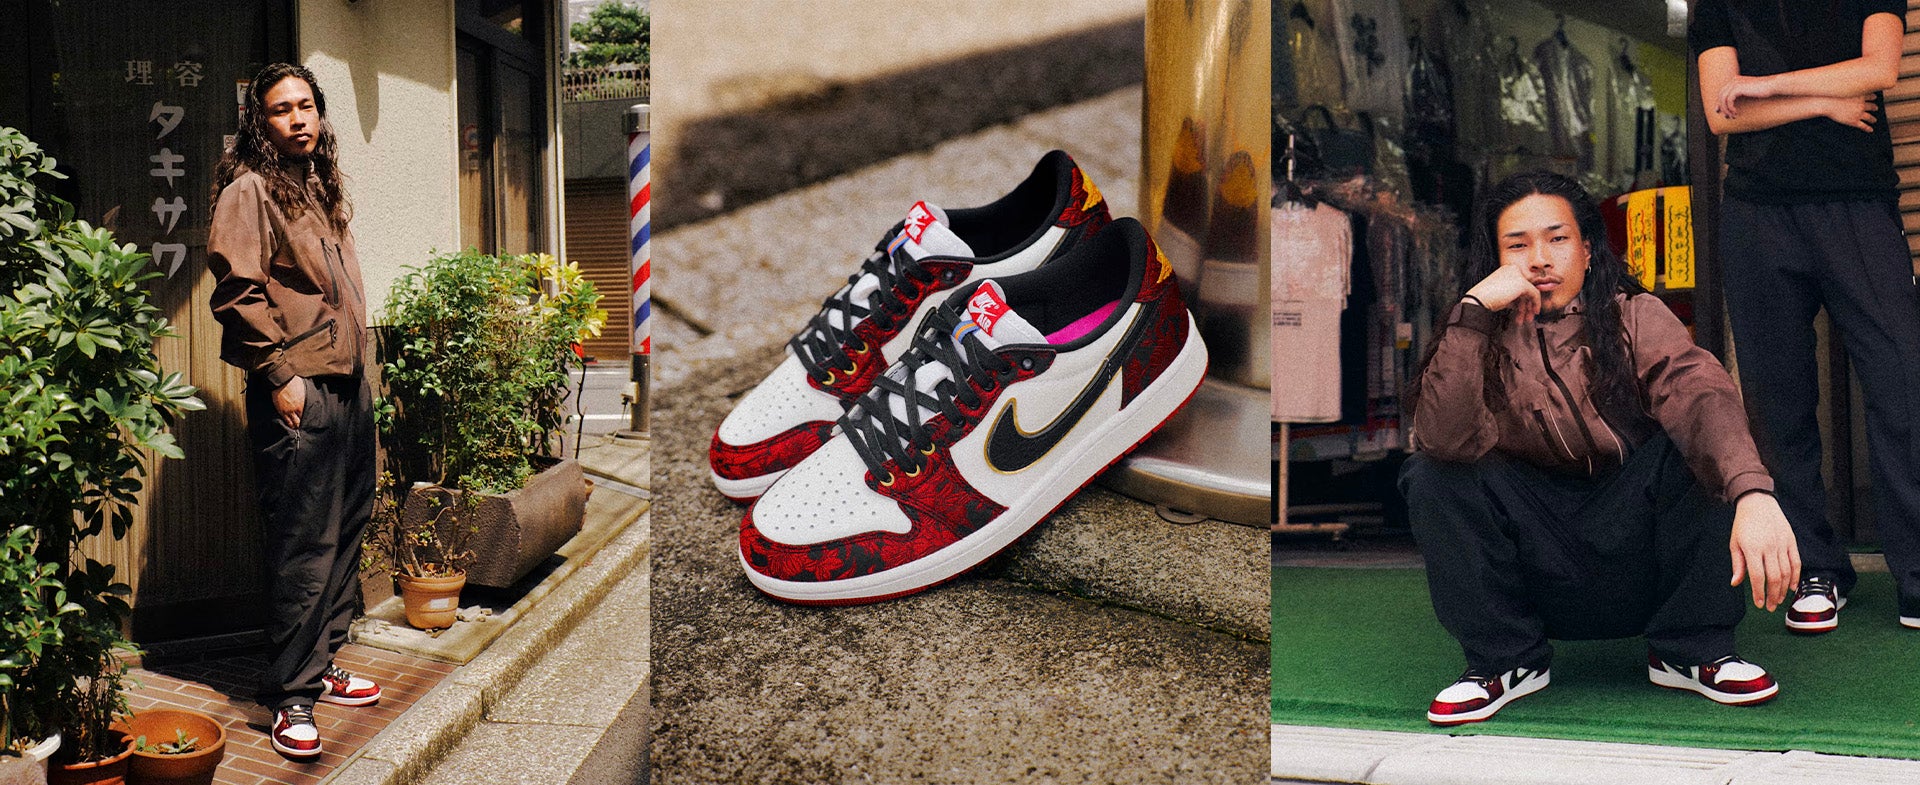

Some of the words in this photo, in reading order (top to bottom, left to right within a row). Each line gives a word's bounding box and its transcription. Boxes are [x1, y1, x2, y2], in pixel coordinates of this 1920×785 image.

[125, 59, 205, 87] 理容
[149, 101, 187, 280] タキサワ
[976, 314, 992, 333] AIR
